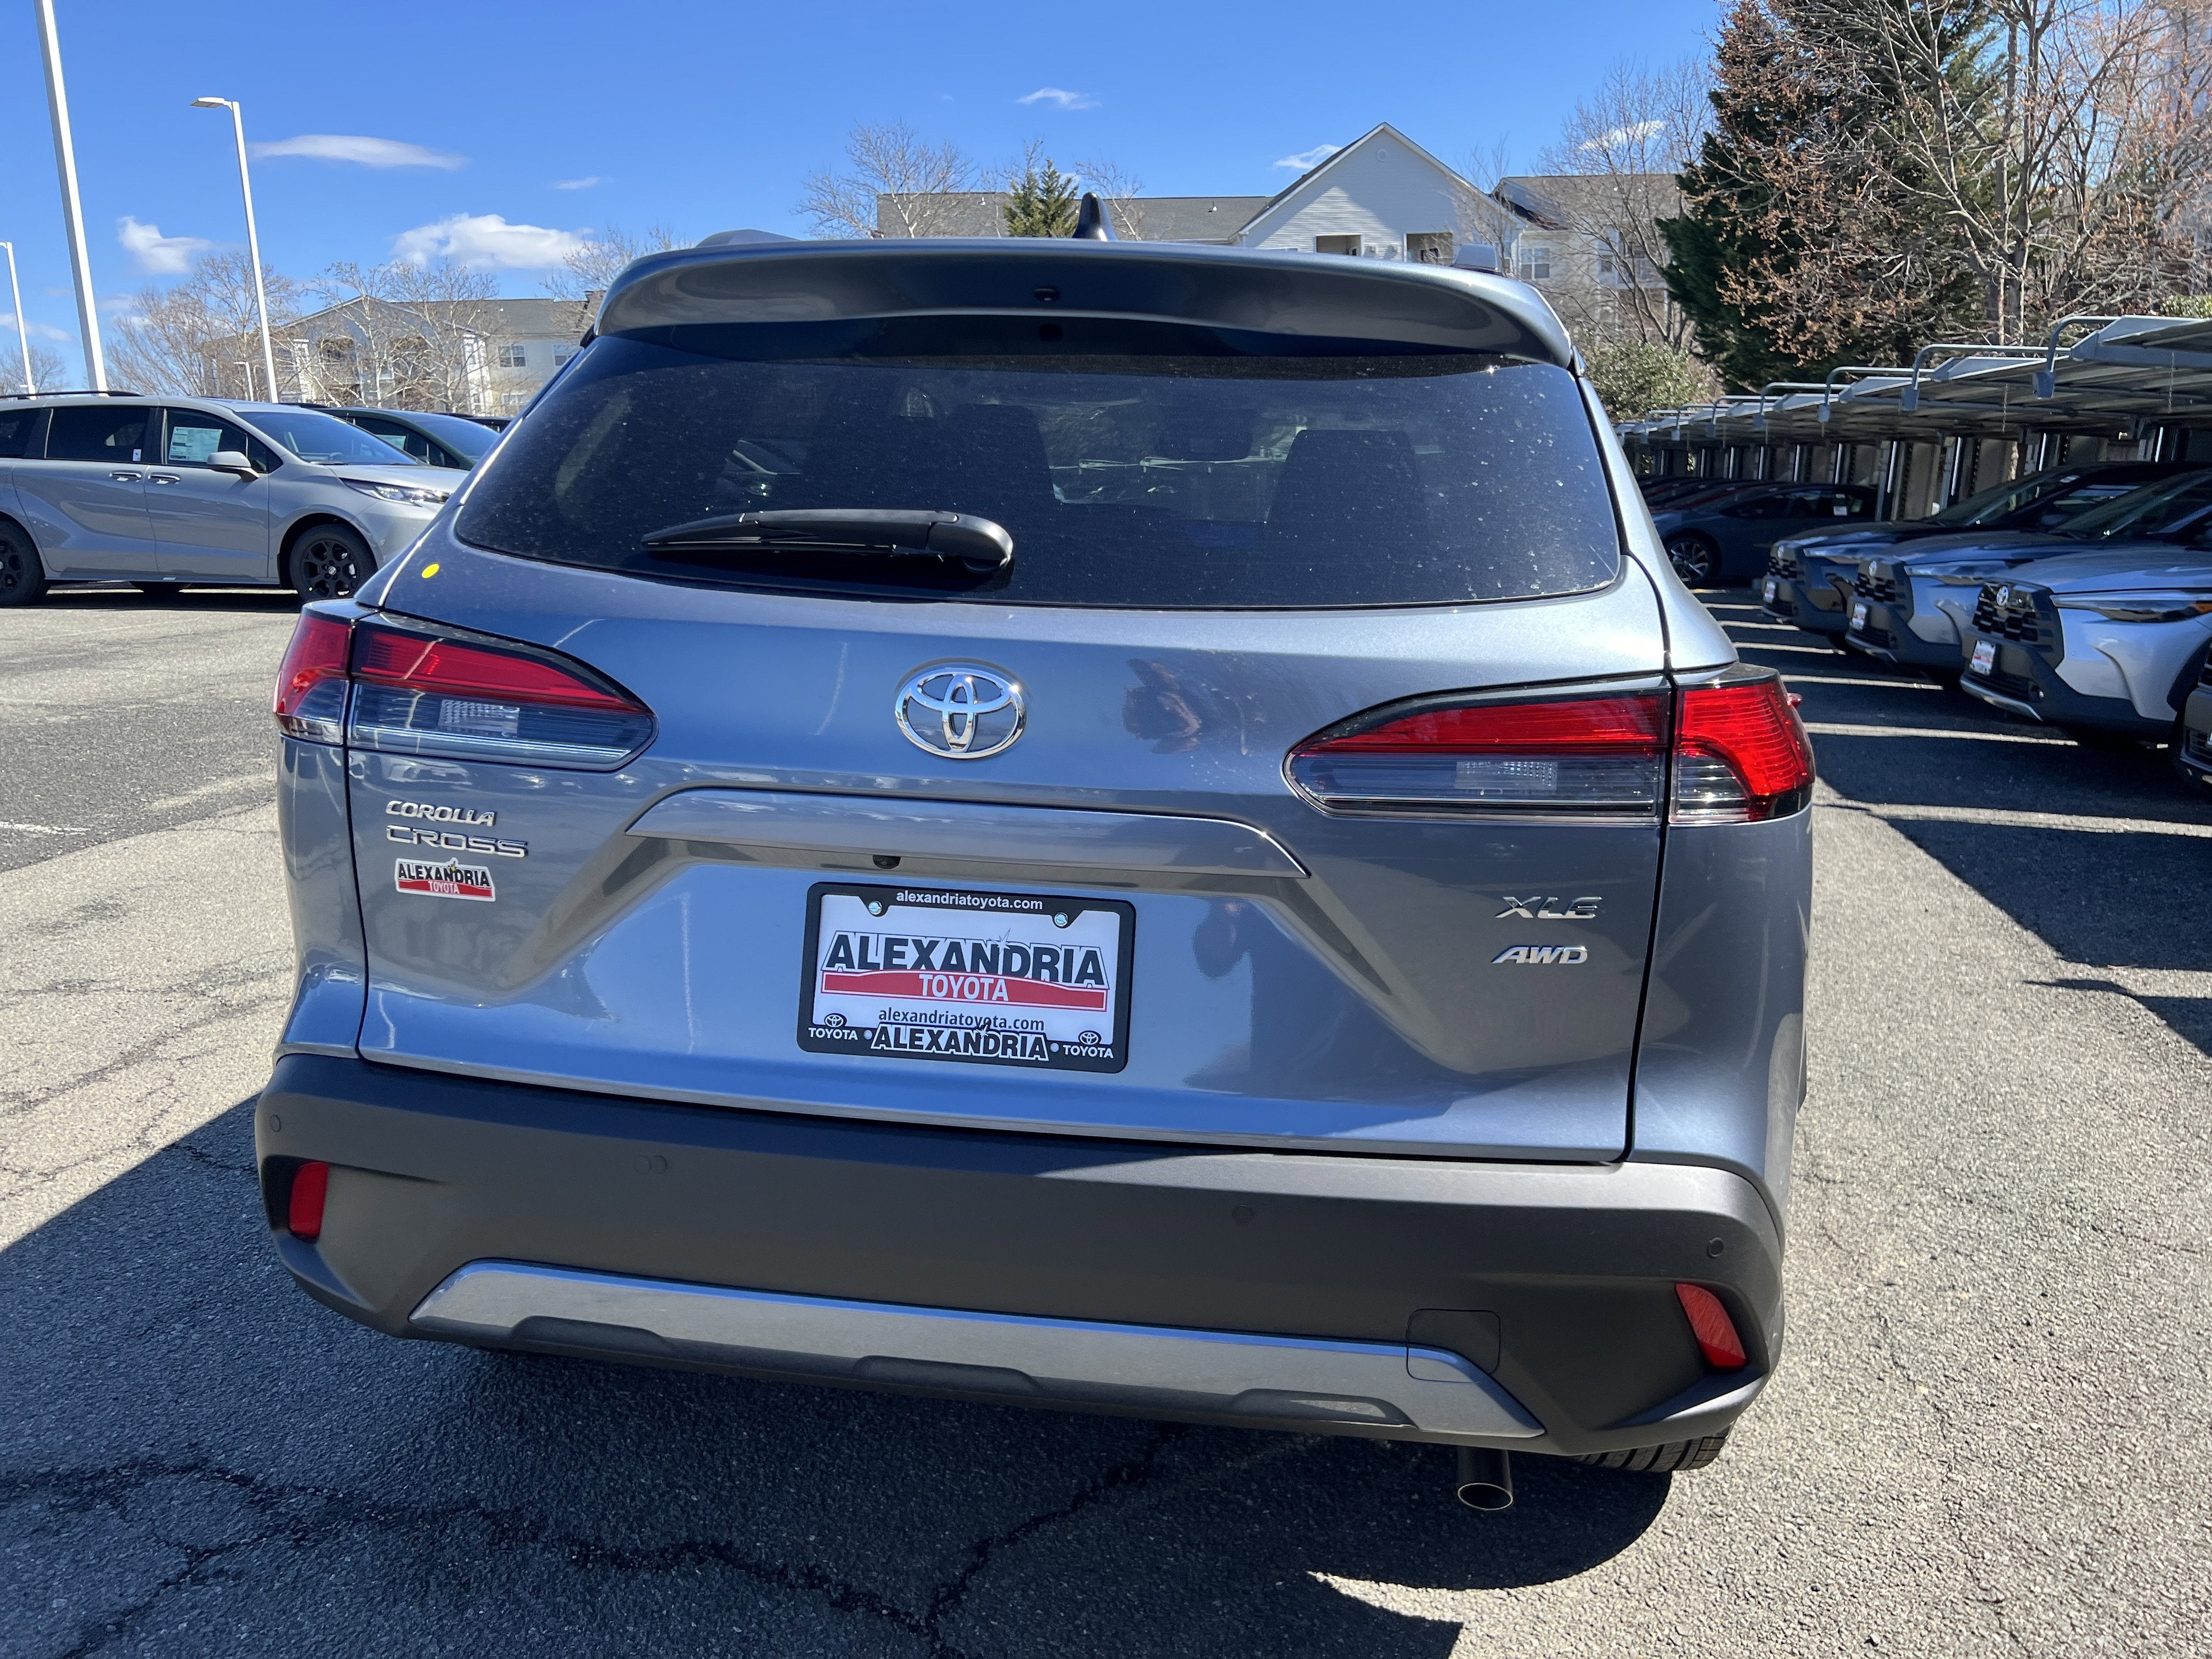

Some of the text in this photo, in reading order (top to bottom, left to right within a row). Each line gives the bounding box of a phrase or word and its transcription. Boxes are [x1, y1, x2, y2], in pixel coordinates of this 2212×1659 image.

[386, 800, 497, 827] COROLLA
[386, 825, 528, 858] CROSS
[398, 863, 490, 887] ALEXANDRIA
[428, 881, 460, 894] TOYOTA
[896, 890, 1043, 910] alexandriatoyota.com
[1495, 896, 1602, 919] XLE
[825, 934, 1105, 986] ALEXANDRIA
[1492, 946, 1588, 964] AWD
[919, 974, 1009, 1002] TOYOTA
[808, 1027, 858, 1041] TOYOTA
[871, 1024, 1049, 1061] ALEXANDRIA
[1063, 1045, 1114, 1059] TOYOTA
